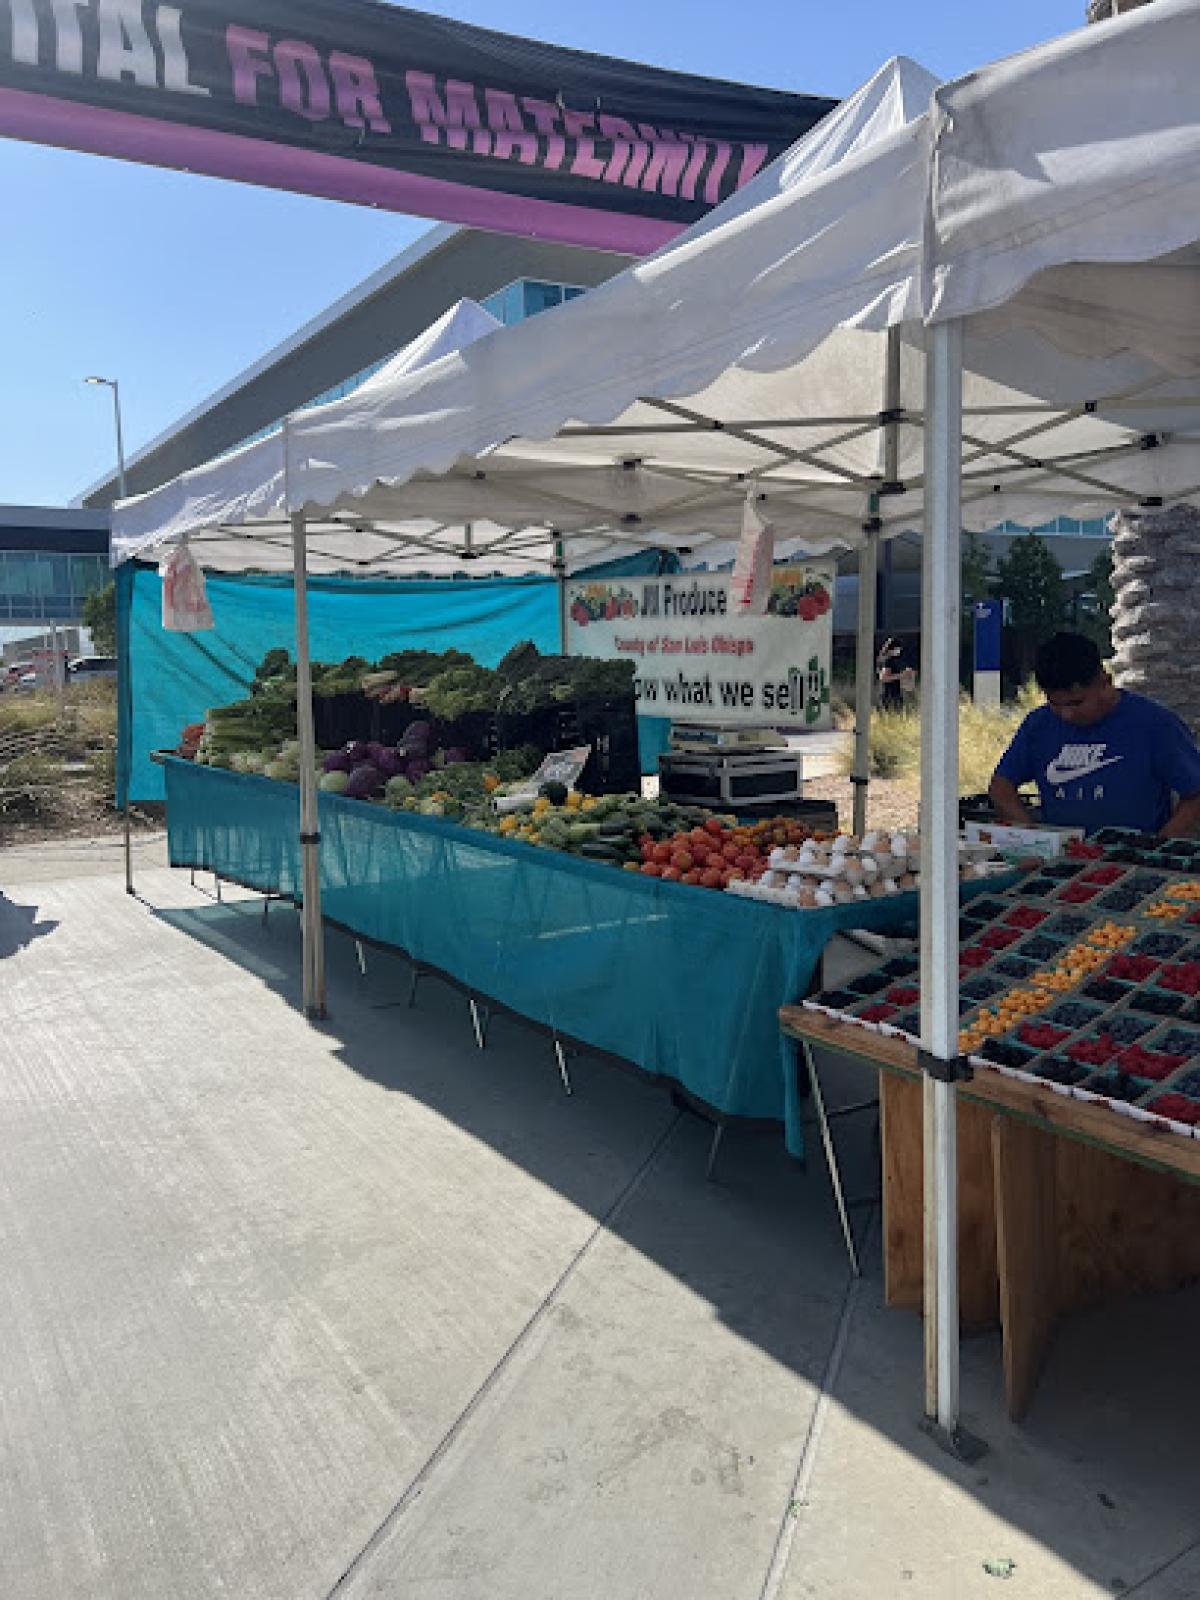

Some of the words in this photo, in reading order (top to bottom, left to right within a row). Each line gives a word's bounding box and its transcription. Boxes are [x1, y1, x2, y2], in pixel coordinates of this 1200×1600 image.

[225, 23, 392, 133] FOR
[664, 581, 727, 617] Produce
[663, 668, 713, 705] what
[718, 680, 754, 707] we
